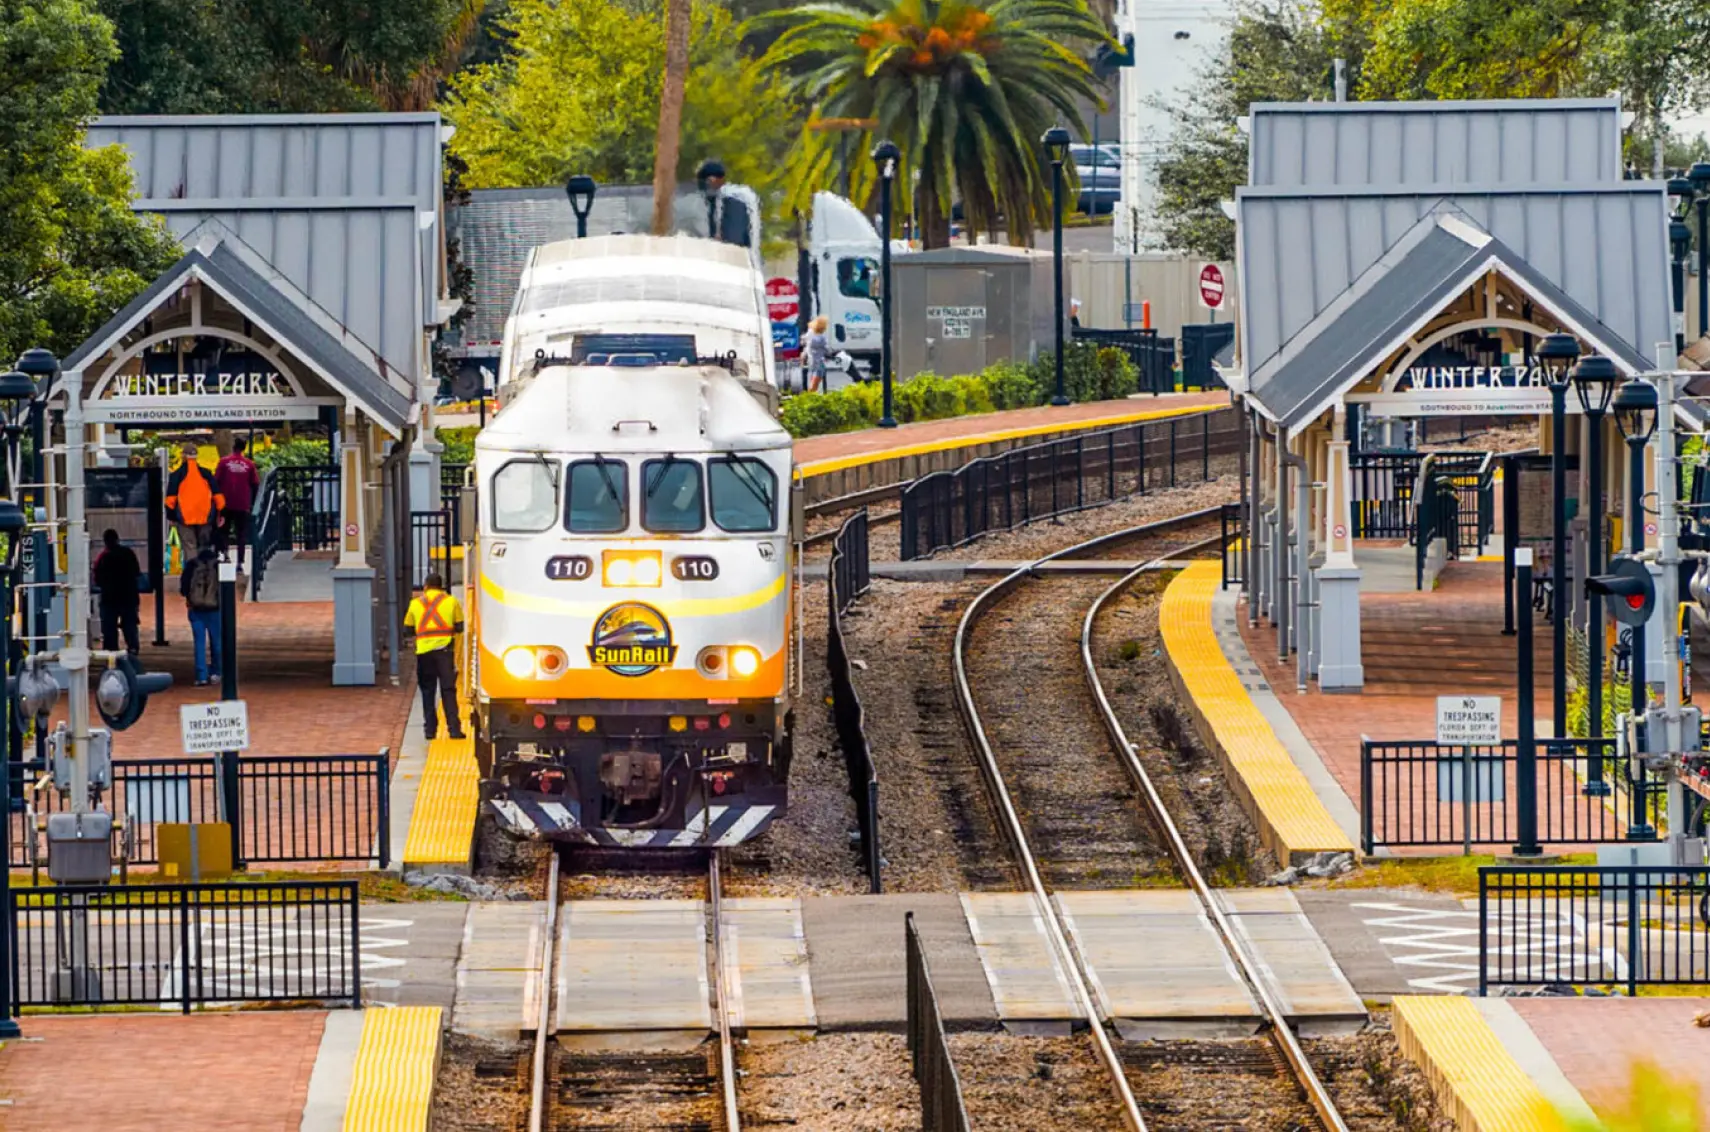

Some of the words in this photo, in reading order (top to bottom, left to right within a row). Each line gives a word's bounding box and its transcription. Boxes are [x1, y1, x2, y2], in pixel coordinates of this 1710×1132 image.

[114, 373, 206, 396] WINTER
[218, 372, 279, 395] PARK
[1409, 366, 1503, 389] WINTER
[1514, 365, 1573, 389] PAR
[110, 411, 177, 419] NORTHBOUND
[194, 410, 243, 418] MAITLAND
[246, 409, 286, 417] STATION
[552, 561, 587, 576] 110
[677, 561, 713, 576] 110
[595, 646, 669, 663] SunRail
[207, 706, 220, 716] NO
[1463, 700, 1476, 709] NO
[189, 717, 241, 730] TRESPASSING
[1444, 712, 1494, 721] TRESPASSING
